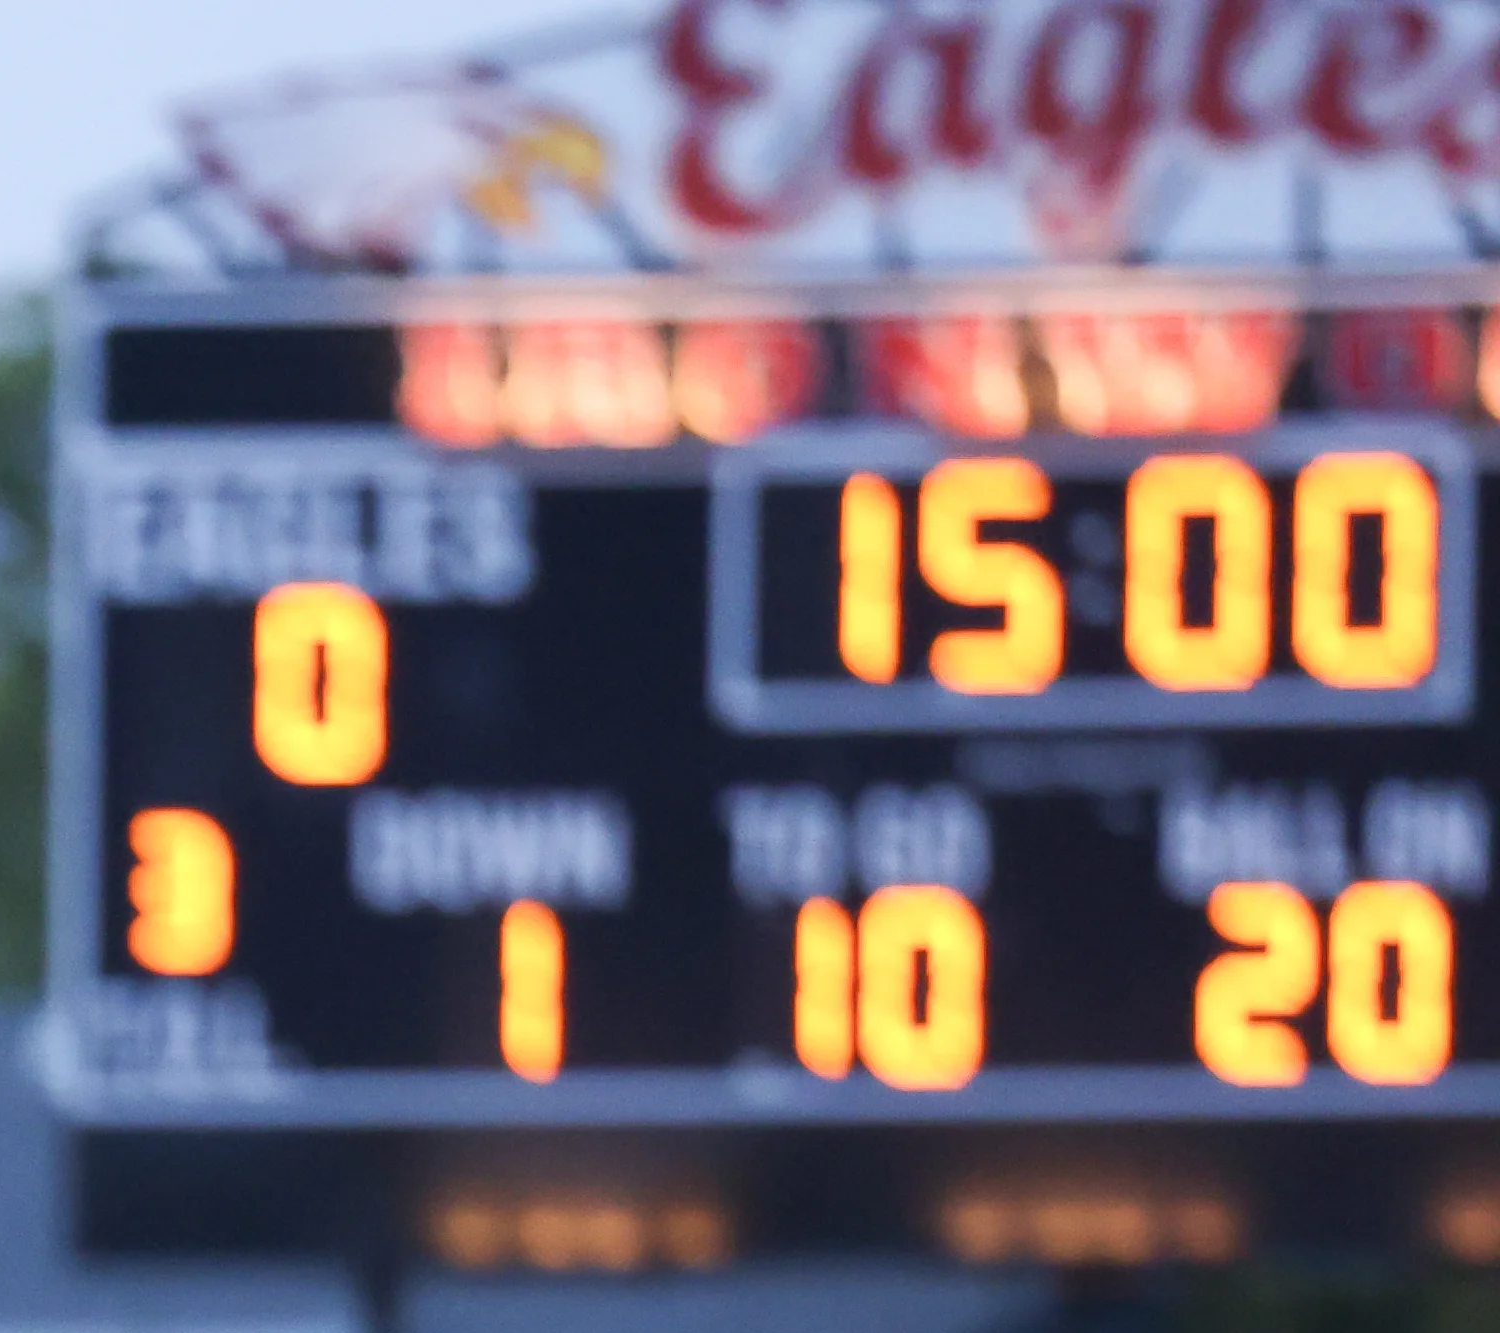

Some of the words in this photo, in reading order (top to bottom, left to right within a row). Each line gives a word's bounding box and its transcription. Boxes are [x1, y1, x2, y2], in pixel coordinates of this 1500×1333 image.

[250, 582, 390, 786] 0
[794, 883, 988, 1092] 10
[1193, 880, 1456, 1089] 20
